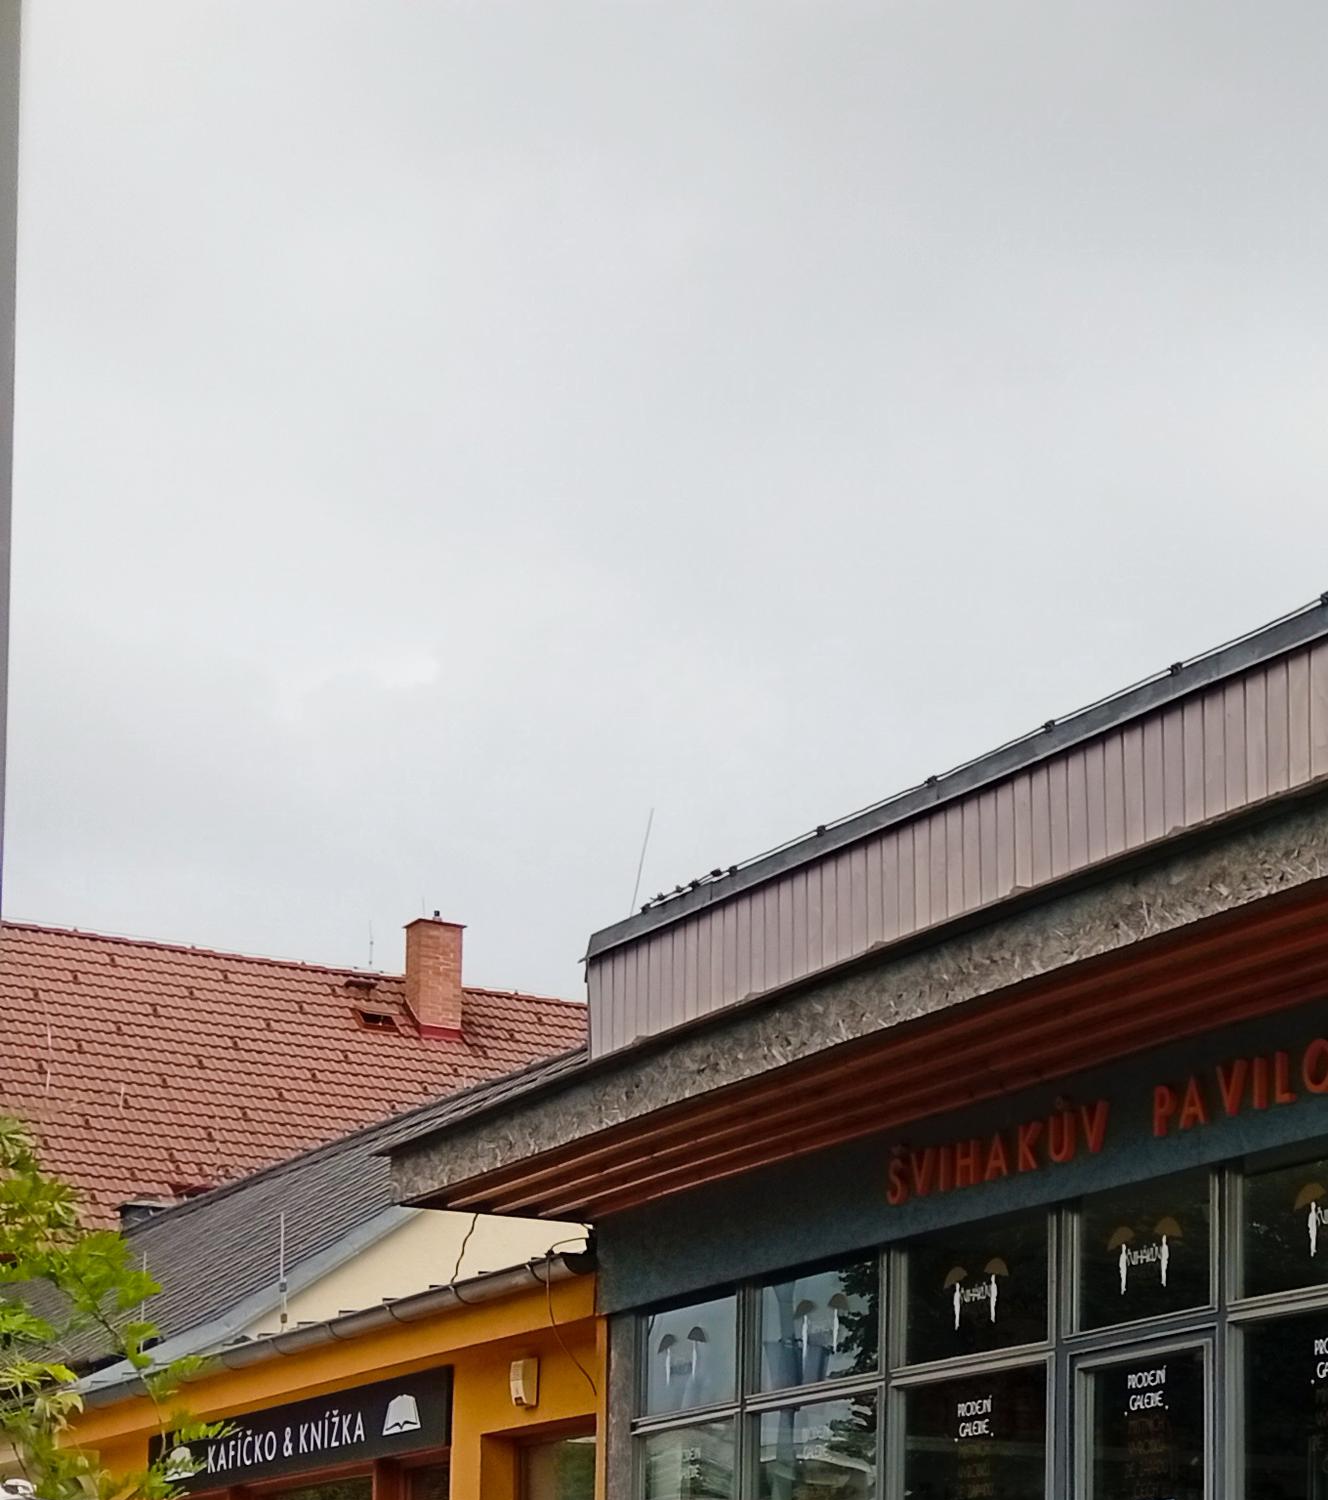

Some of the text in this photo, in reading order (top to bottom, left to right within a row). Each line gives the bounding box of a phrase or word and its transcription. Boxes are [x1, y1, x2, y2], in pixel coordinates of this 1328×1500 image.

[207, 1409, 366, 1474] KAFÍČKO & KNÍŽKA
